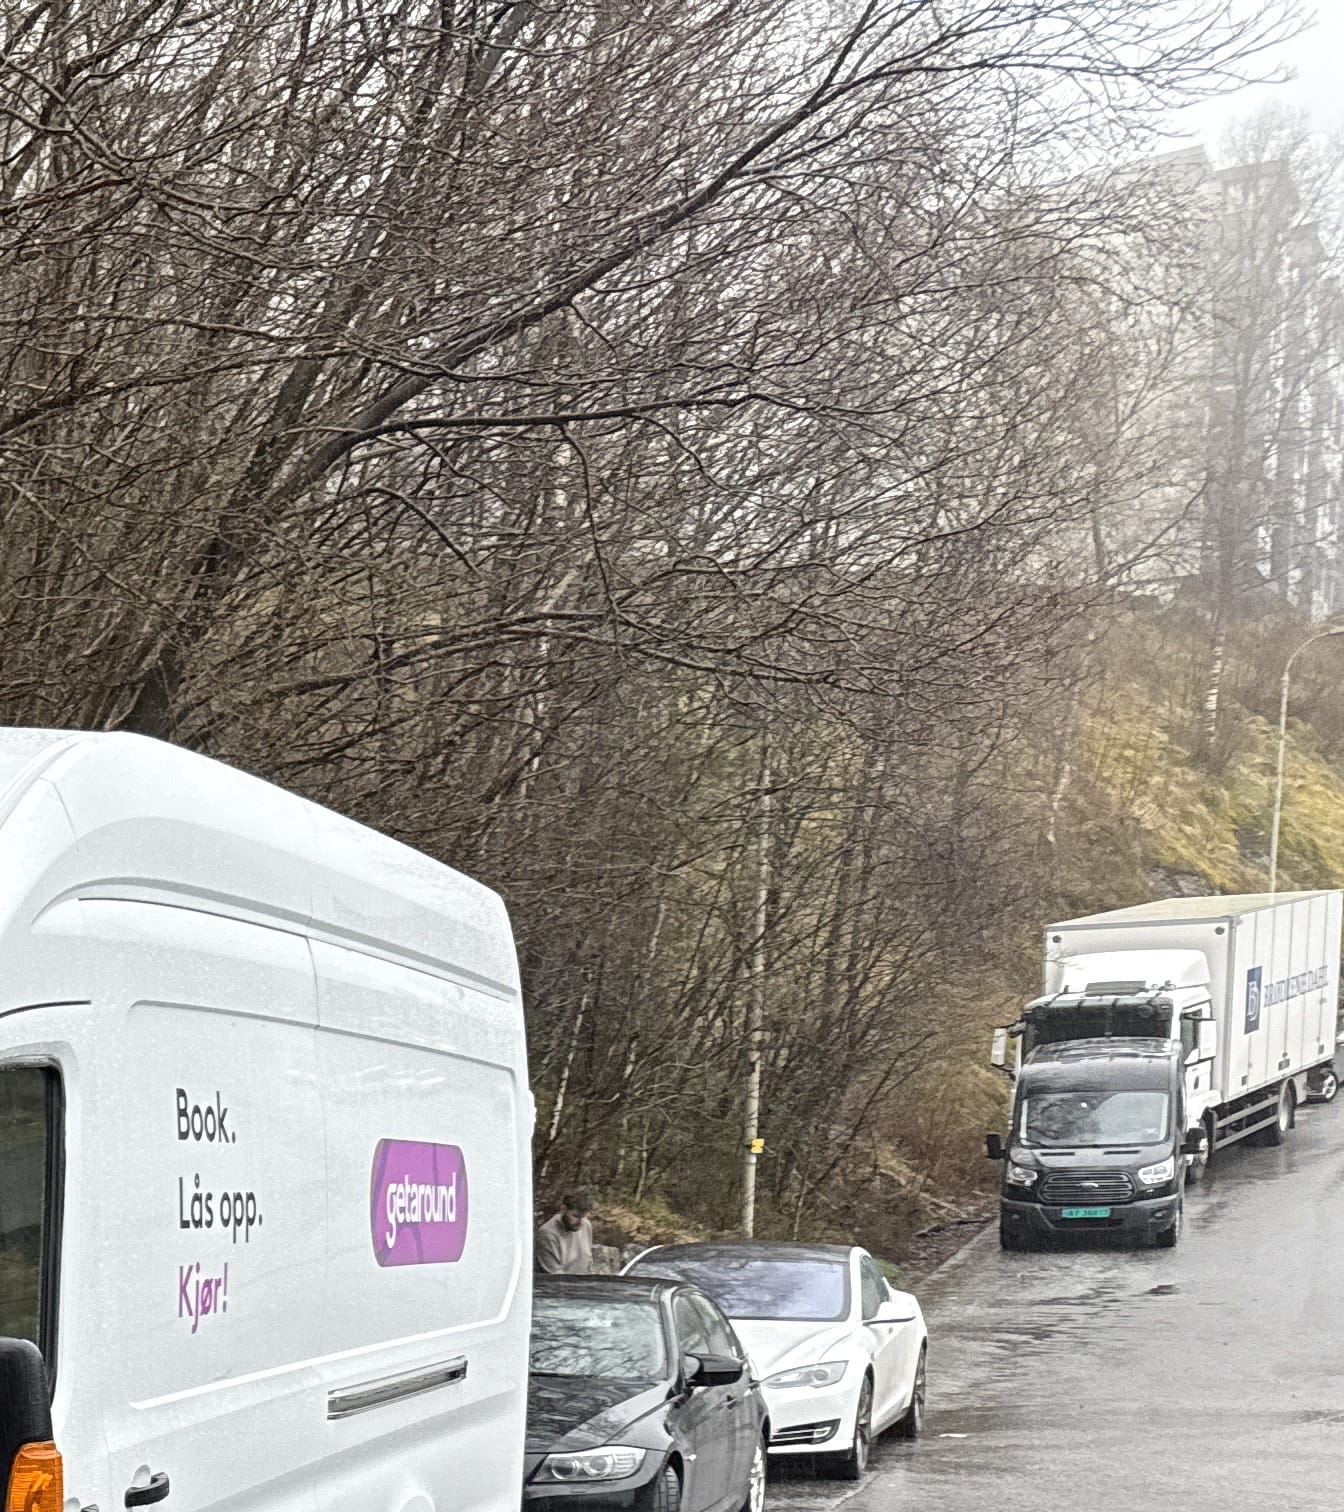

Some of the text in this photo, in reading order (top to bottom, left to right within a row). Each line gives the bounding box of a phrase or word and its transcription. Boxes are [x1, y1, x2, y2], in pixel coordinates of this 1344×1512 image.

[175, 1087, 236, 1144] Book.
[178, 1172, 263, 1244] Lås opp.
[385, 1171, 457, 1249] getaround
[178, 1261, 229, 1334] Kjør!
